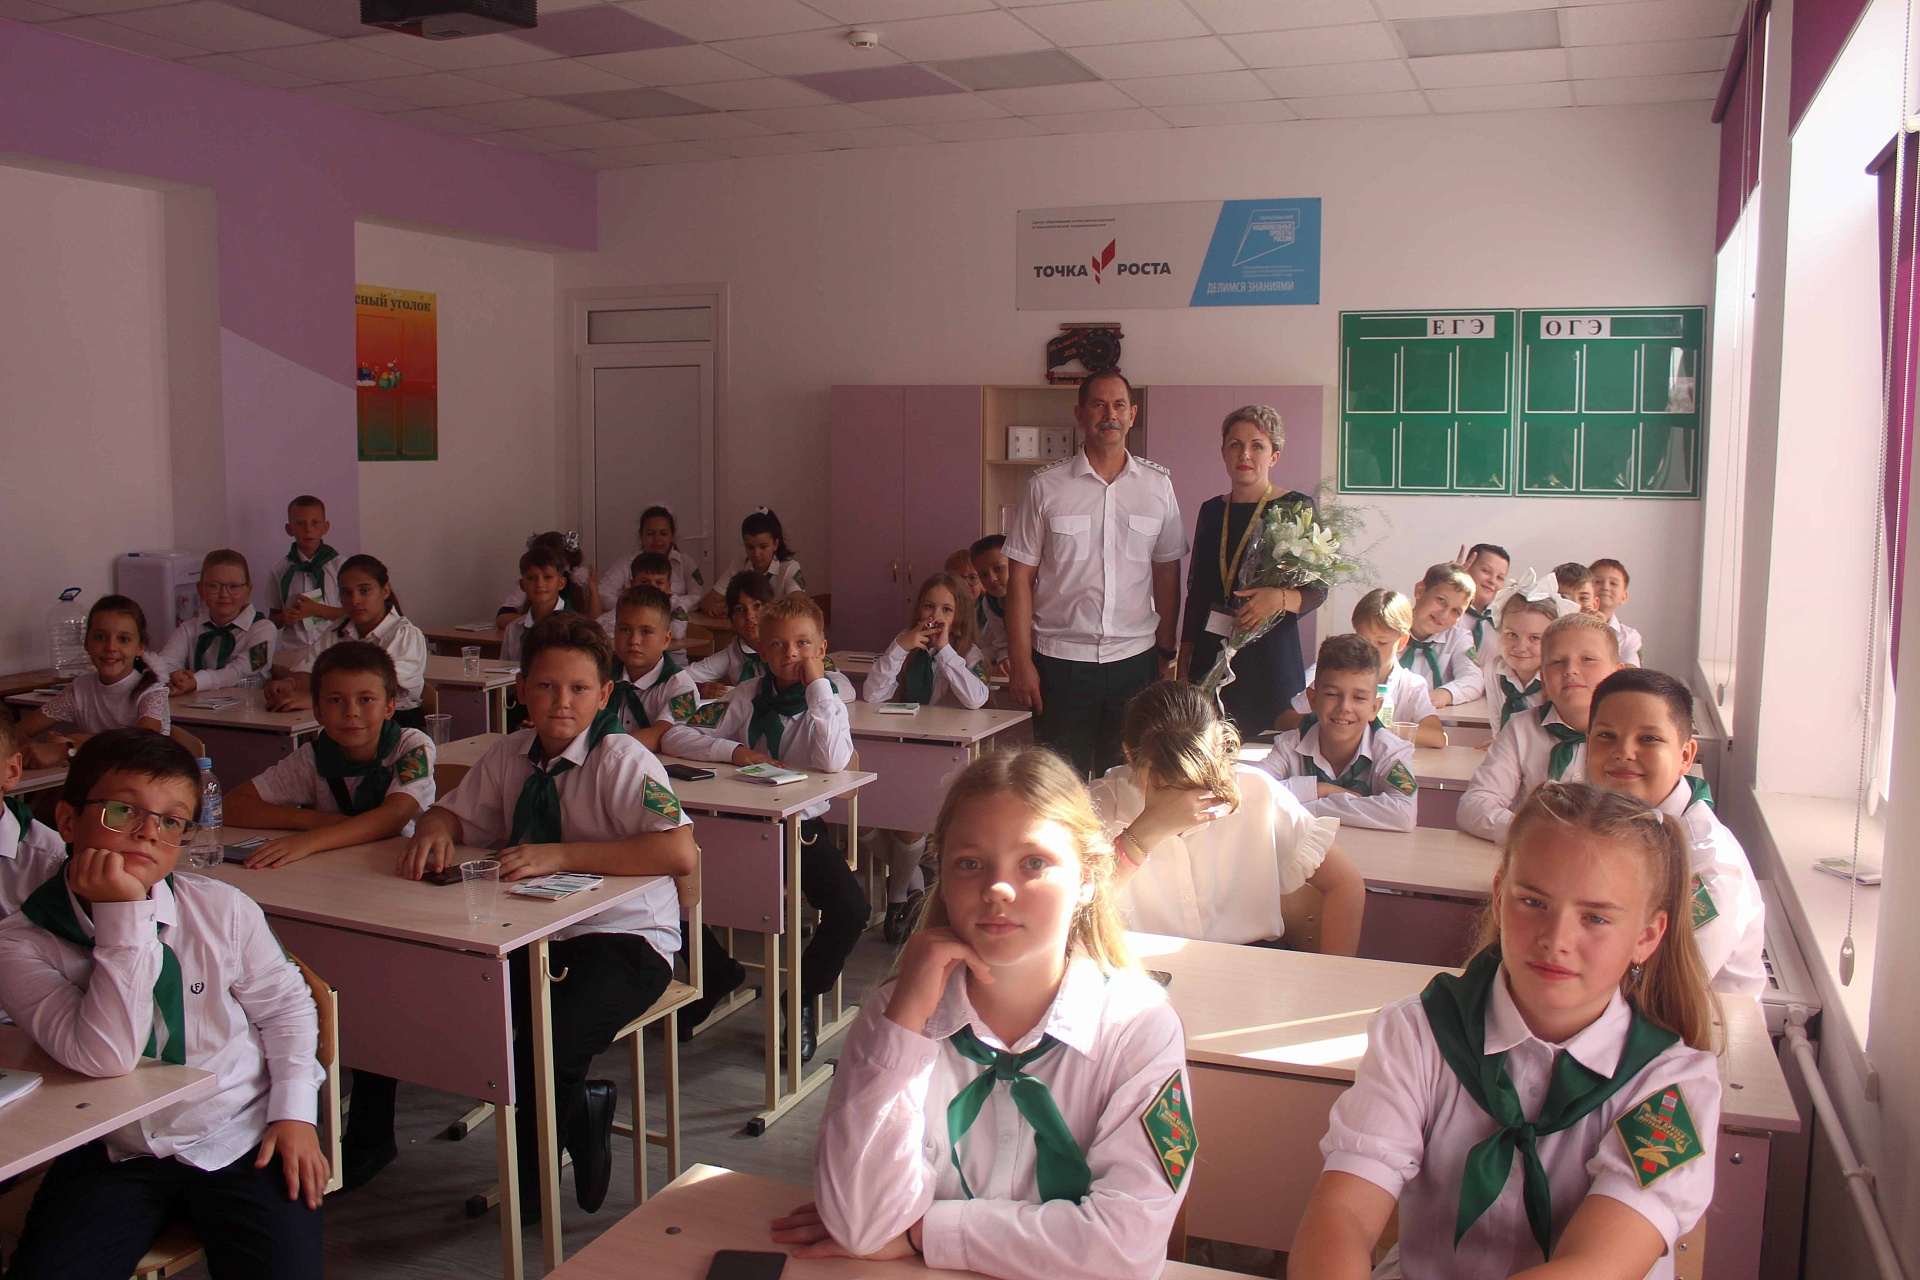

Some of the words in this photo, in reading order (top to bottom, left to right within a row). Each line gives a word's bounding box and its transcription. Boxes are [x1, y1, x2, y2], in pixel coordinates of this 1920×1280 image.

[1033, 264, 1088, 278] ТОЧКА
[1117, 262, 1172, 276] РОСТА
[1207, 282, 1246, 294] ДЕЛИМСЯ
[1247, 281, 1295, 292] ЗНАНИЯМИ
[390, 298, 431, 312] уголок
[1432, 318, 1485, 335] ЕГЭ
[1545, 319, 1602, 336] ОГЭ
